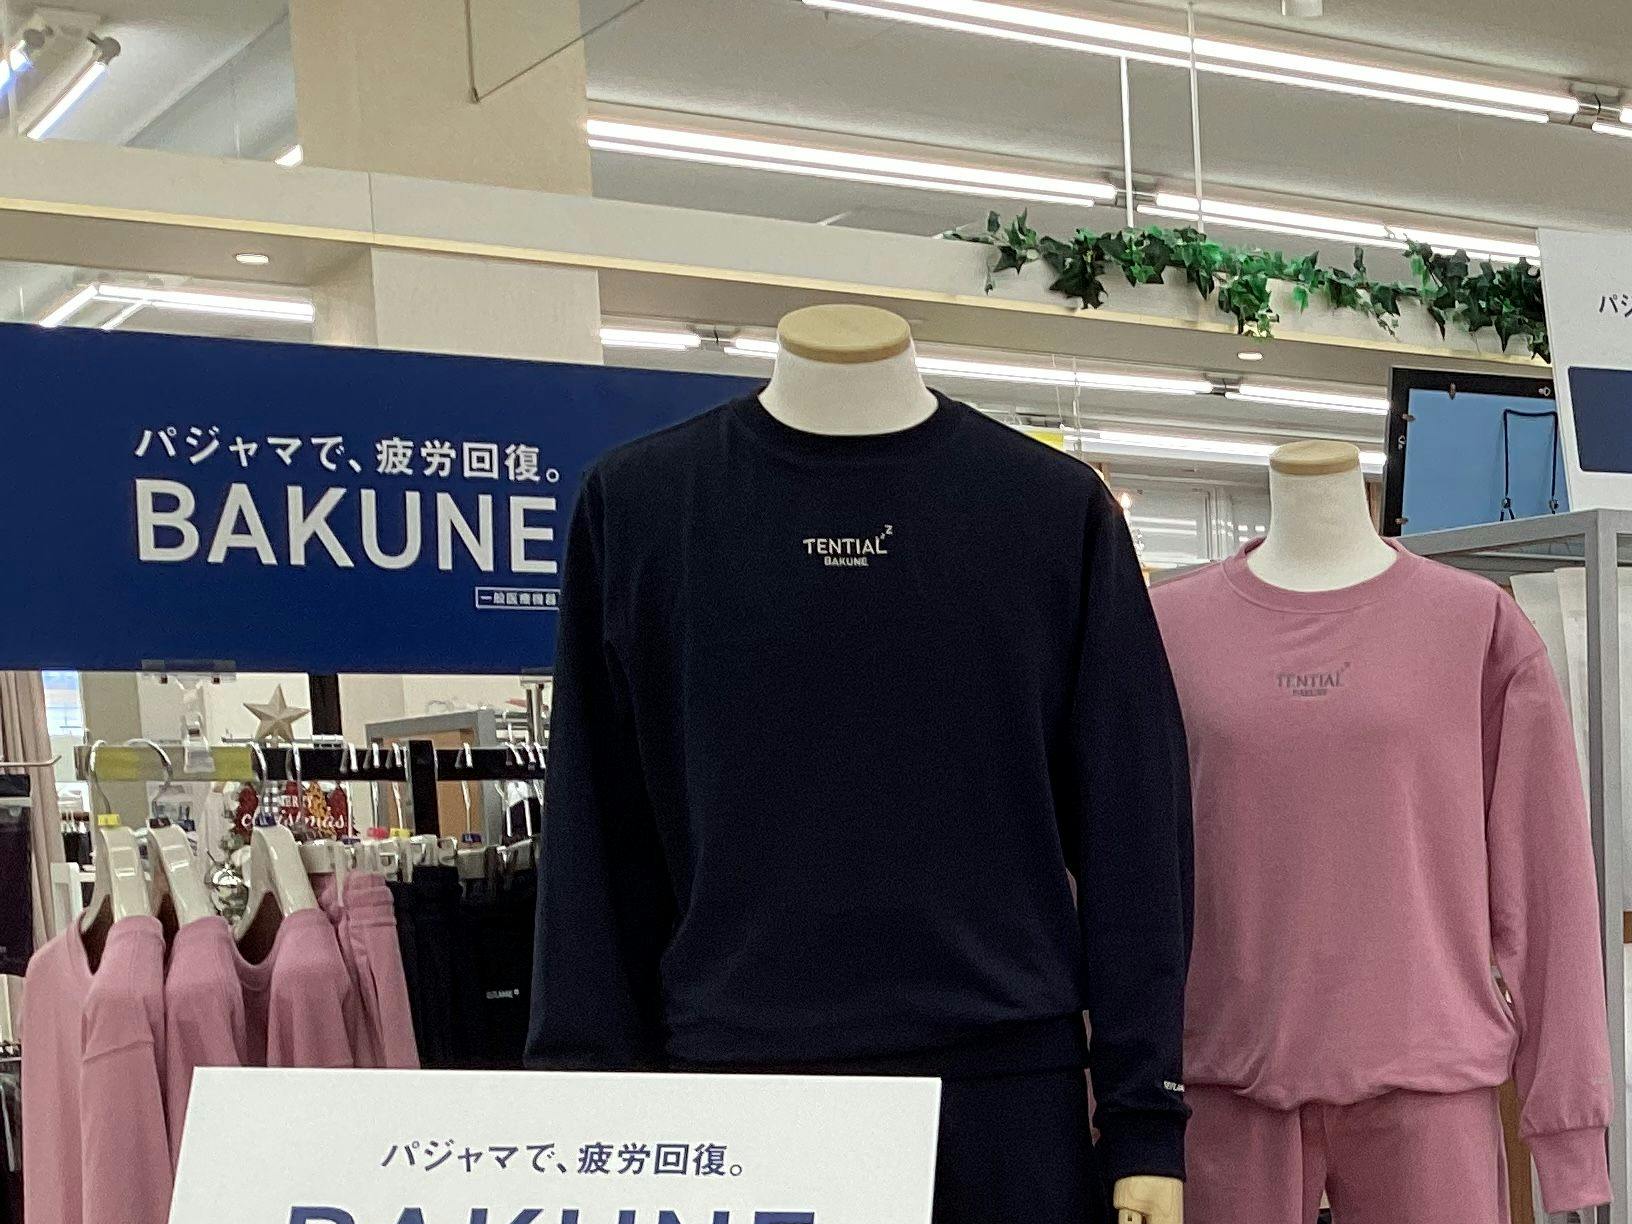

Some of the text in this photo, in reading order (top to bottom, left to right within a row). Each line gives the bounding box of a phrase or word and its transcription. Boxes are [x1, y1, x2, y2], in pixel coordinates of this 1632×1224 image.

[133, 425, 559, 483] パジャマで、疲労回復。
[134, 478, 558, 574] BAKUNE
[803, 536, 887, 555] TENTIAL
[381, 1139, 743, 1177] パジャマで、疲労回復。
